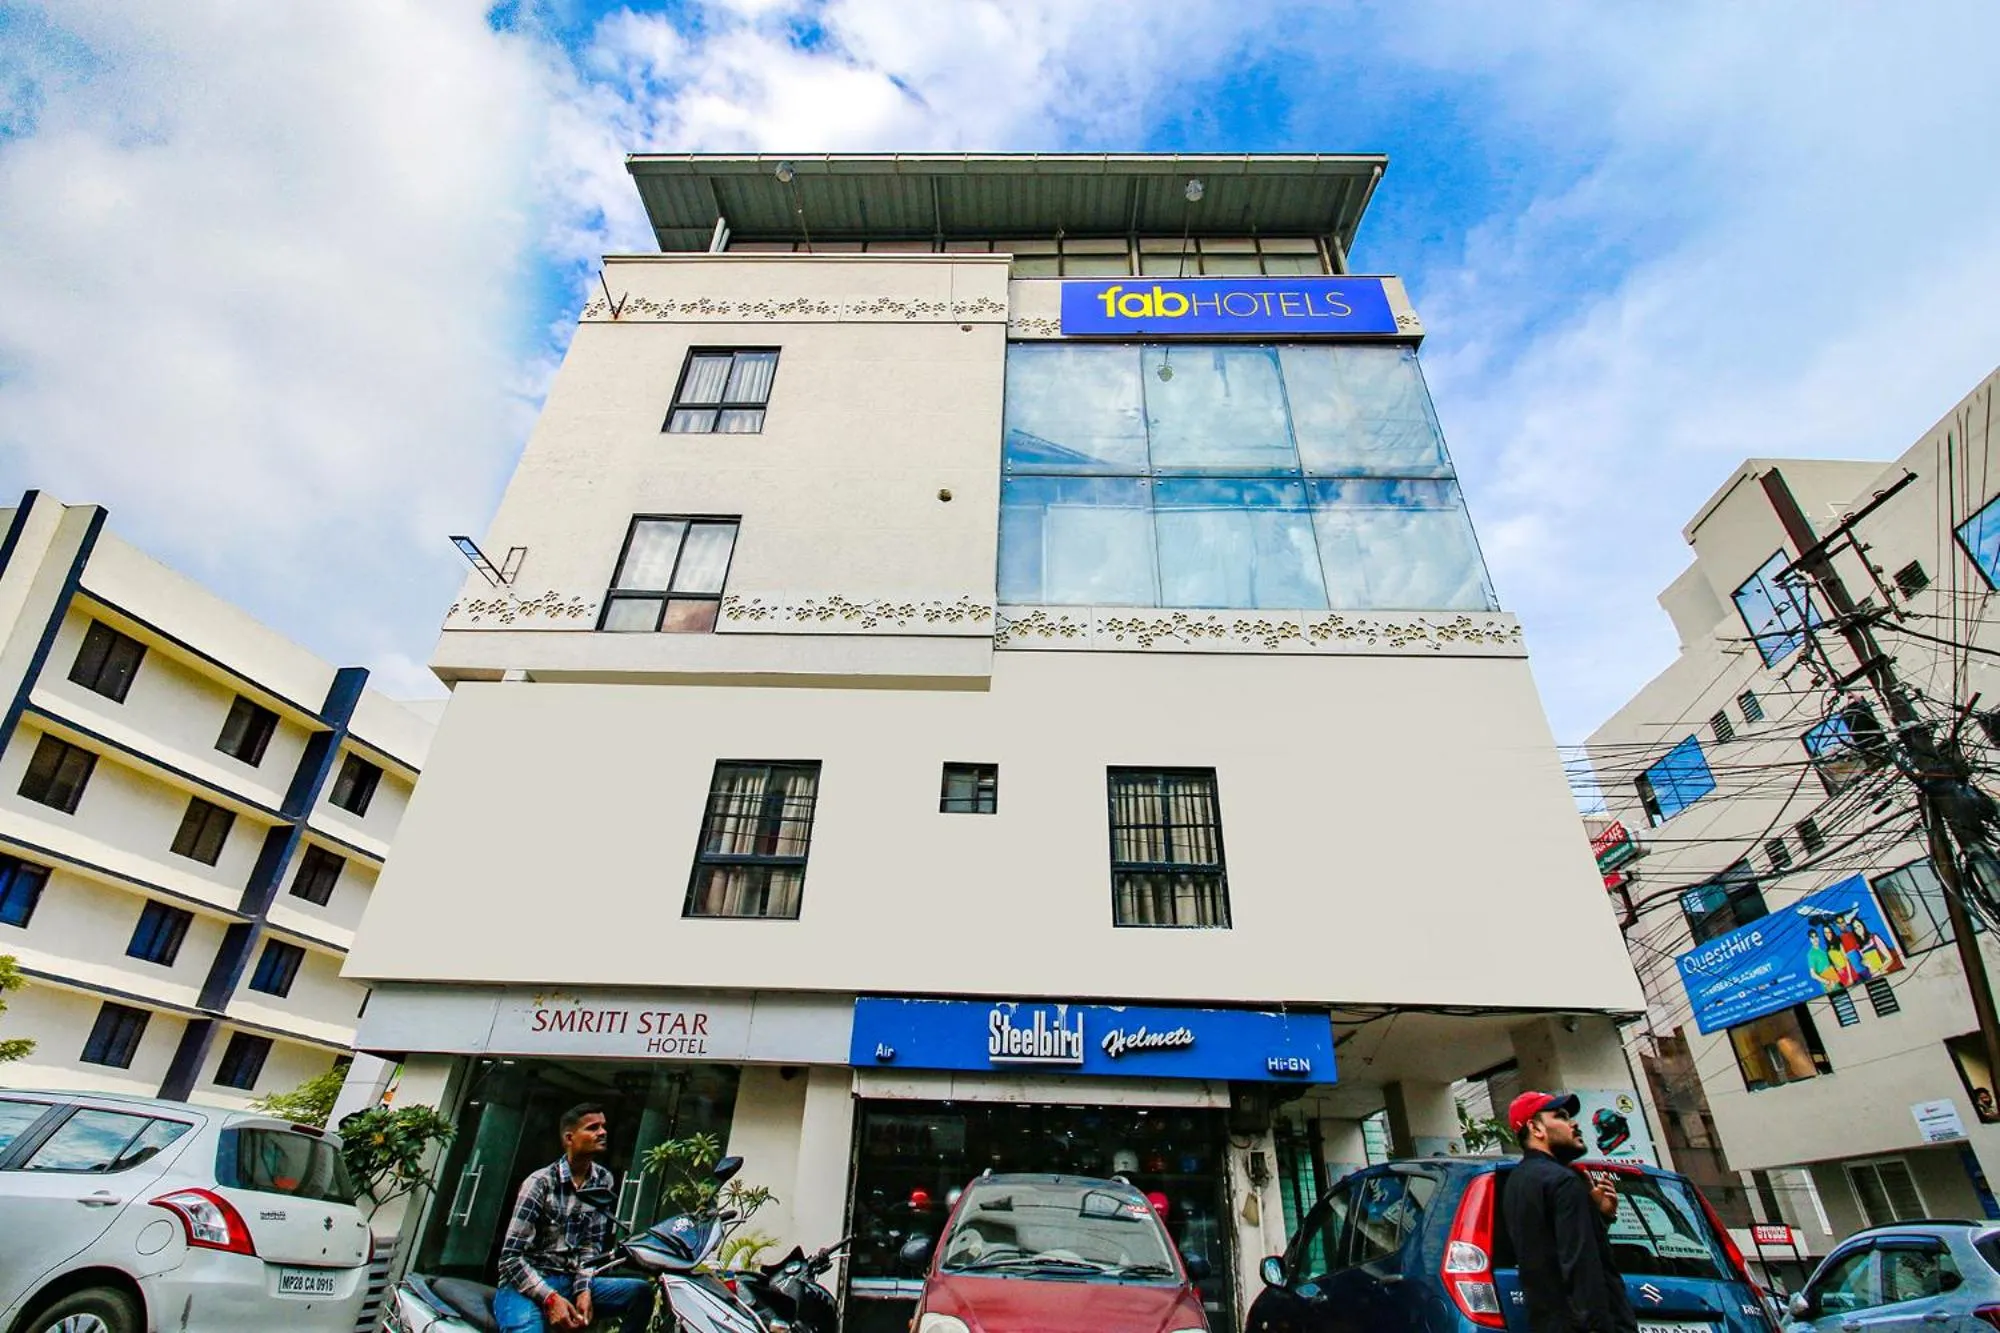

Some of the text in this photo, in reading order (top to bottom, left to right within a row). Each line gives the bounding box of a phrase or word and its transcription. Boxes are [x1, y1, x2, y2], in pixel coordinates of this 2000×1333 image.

[1683, 930, 1763, 974] QuestHire
[532, 1009, 708, 1036] SMRITI STAR
[989, 1009, 1195, 1057] Steelbird Helmets
[647, 1037, 707, 1054] HOTEL
[875, 1042, 894, 1057] Air
